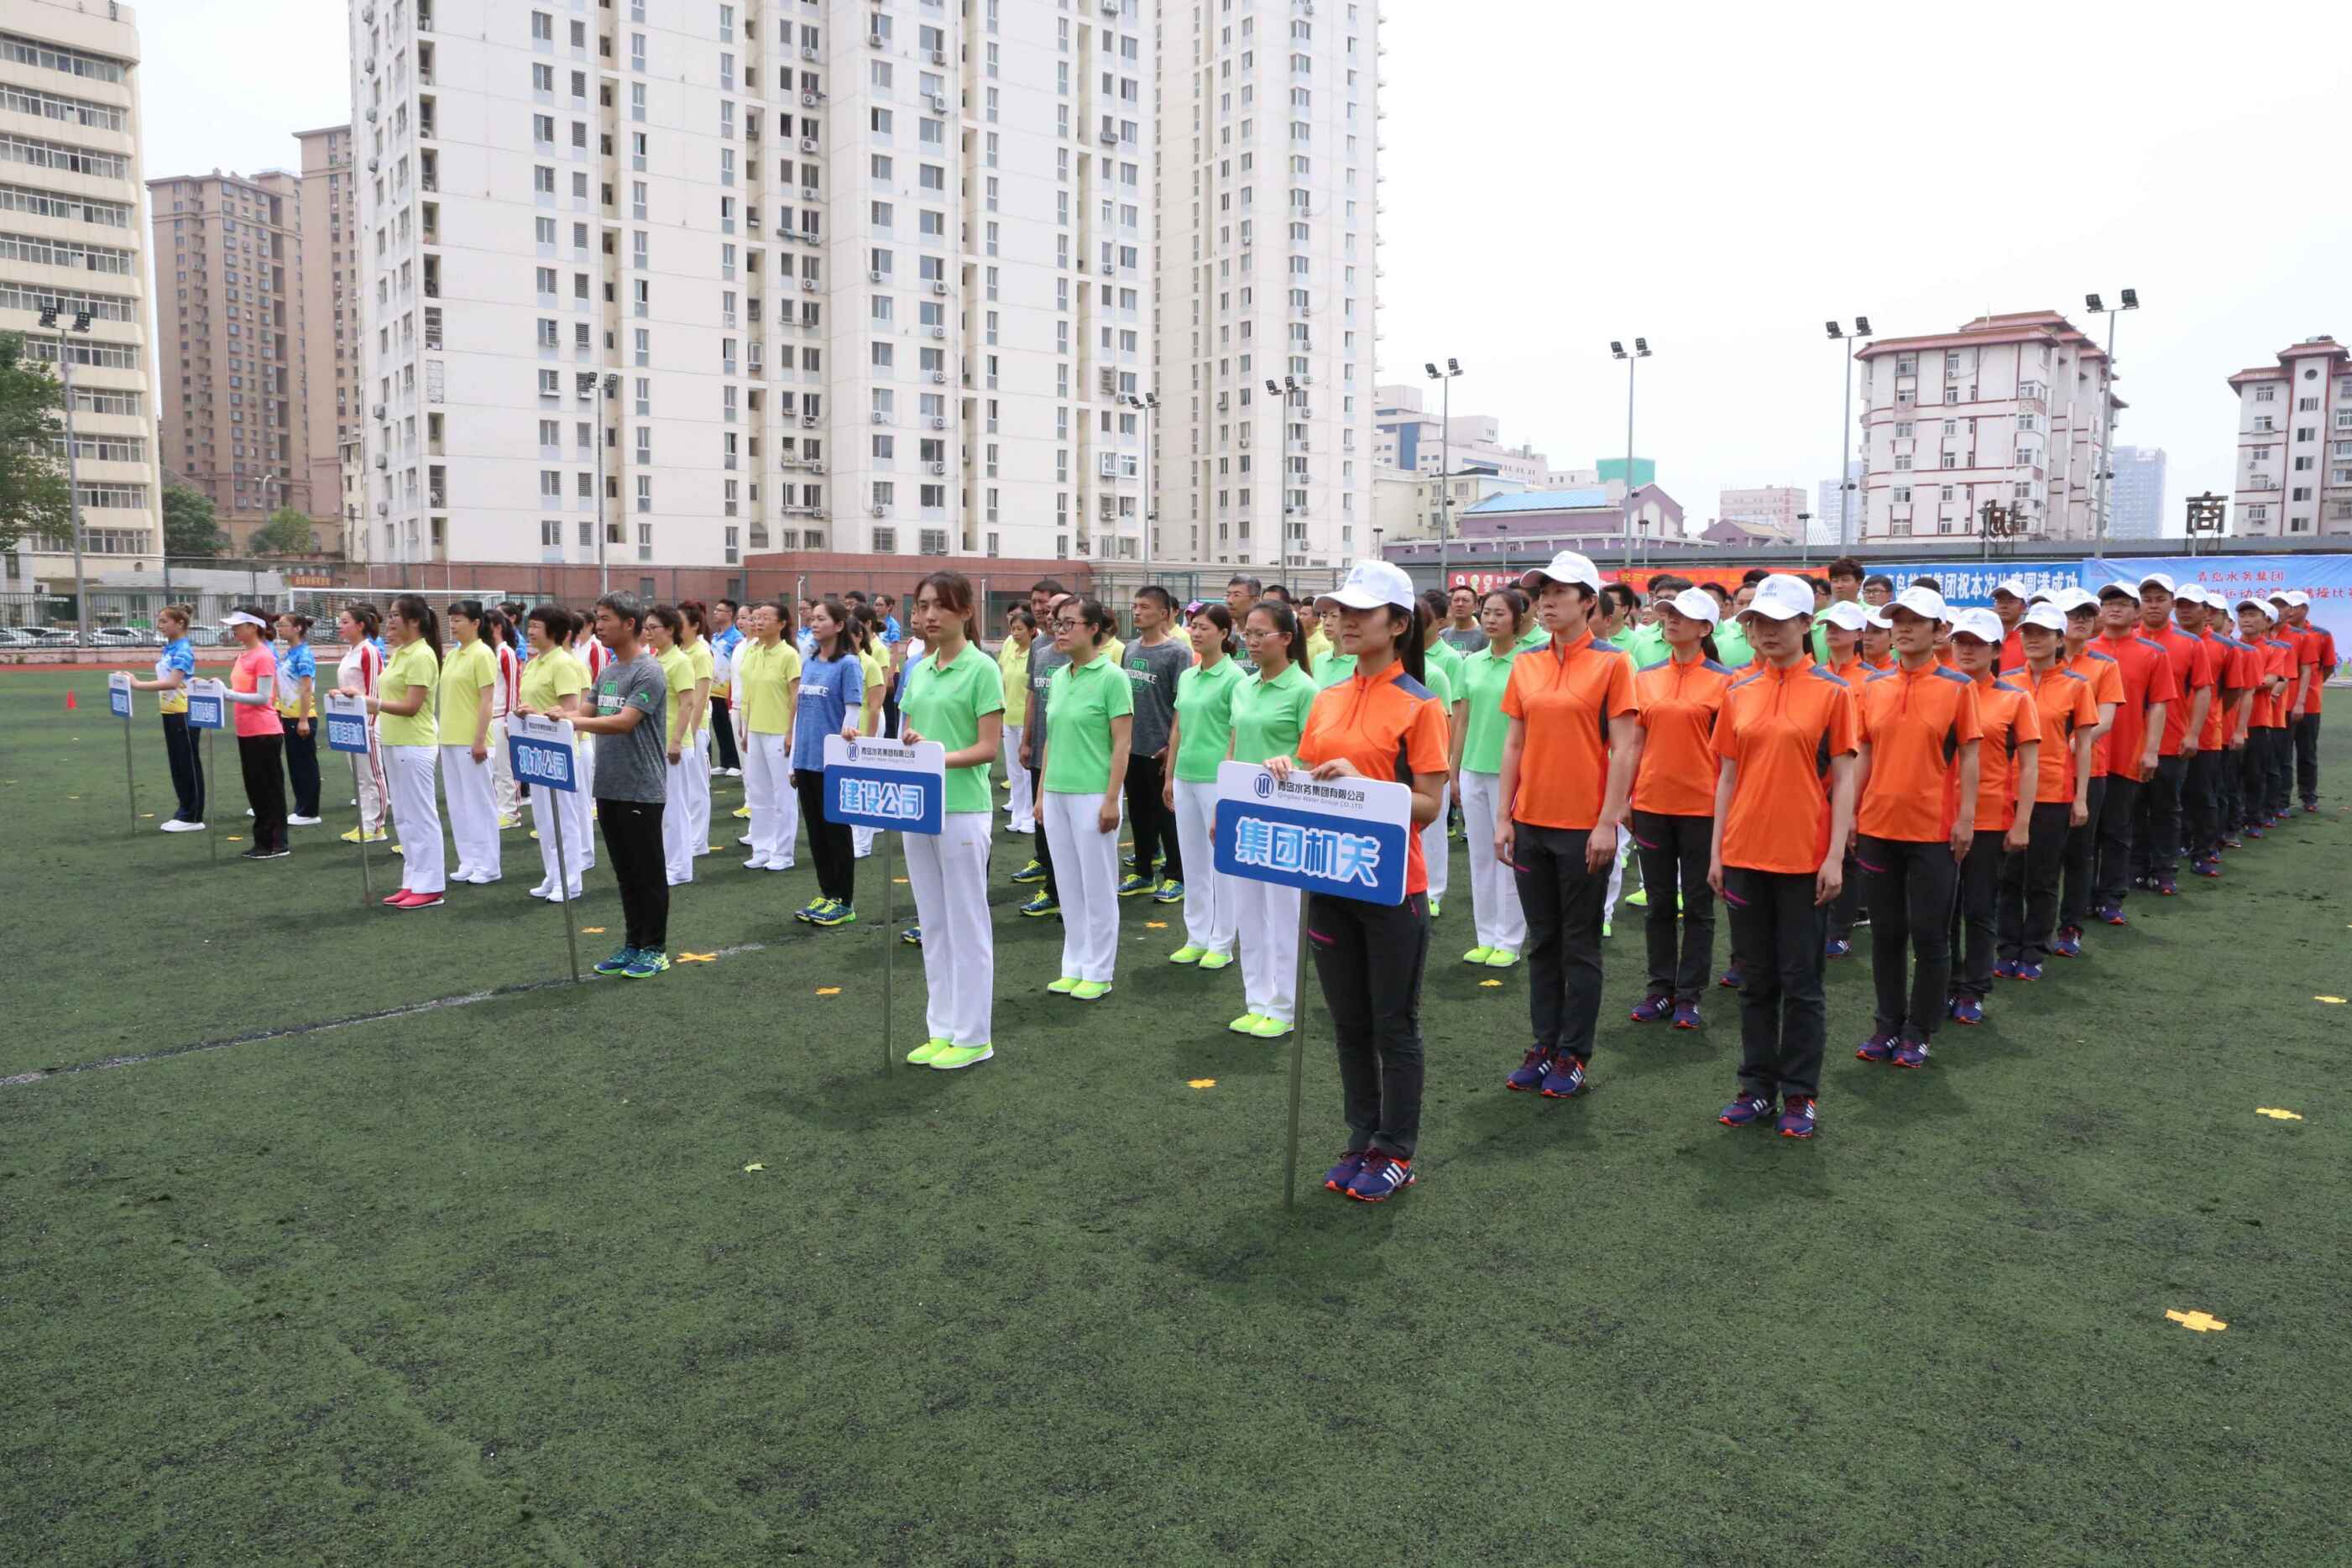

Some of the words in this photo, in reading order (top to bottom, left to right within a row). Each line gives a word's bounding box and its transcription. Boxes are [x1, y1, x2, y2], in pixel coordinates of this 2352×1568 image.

[839, 777, 925, 822] 建设公司
[1278, 780, 1365, 802] 青岛水务集团有限公司
[1234, 815, 1382, 889] 集团机关
